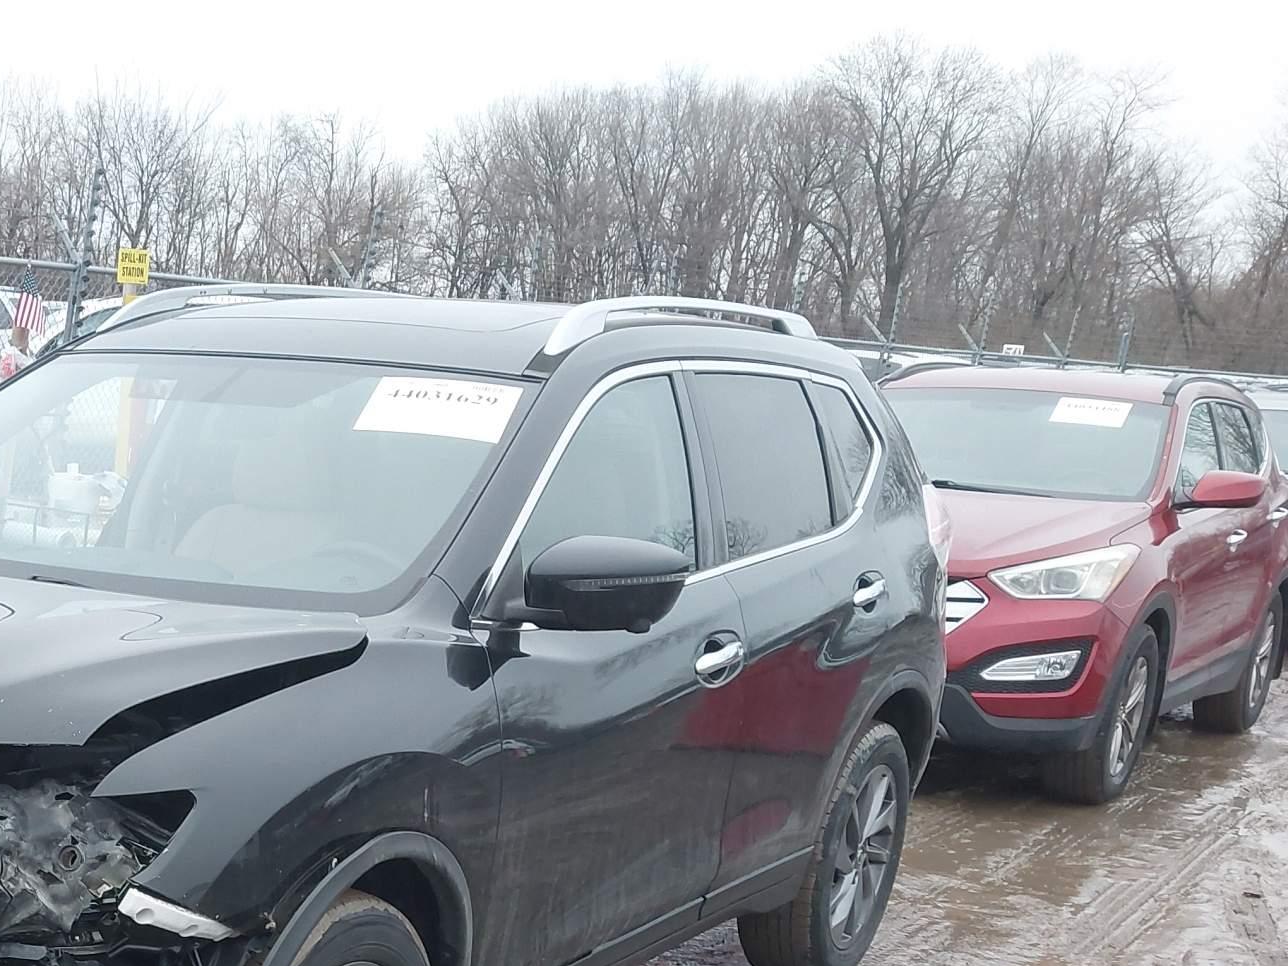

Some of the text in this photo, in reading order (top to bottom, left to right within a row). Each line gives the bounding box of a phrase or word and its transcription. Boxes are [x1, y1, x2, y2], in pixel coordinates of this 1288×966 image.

[120, 251, 148, 264] SPILL-KIT
[121, 266, 145, 278] STATION
[385, 389, 499, 405] 44031629
